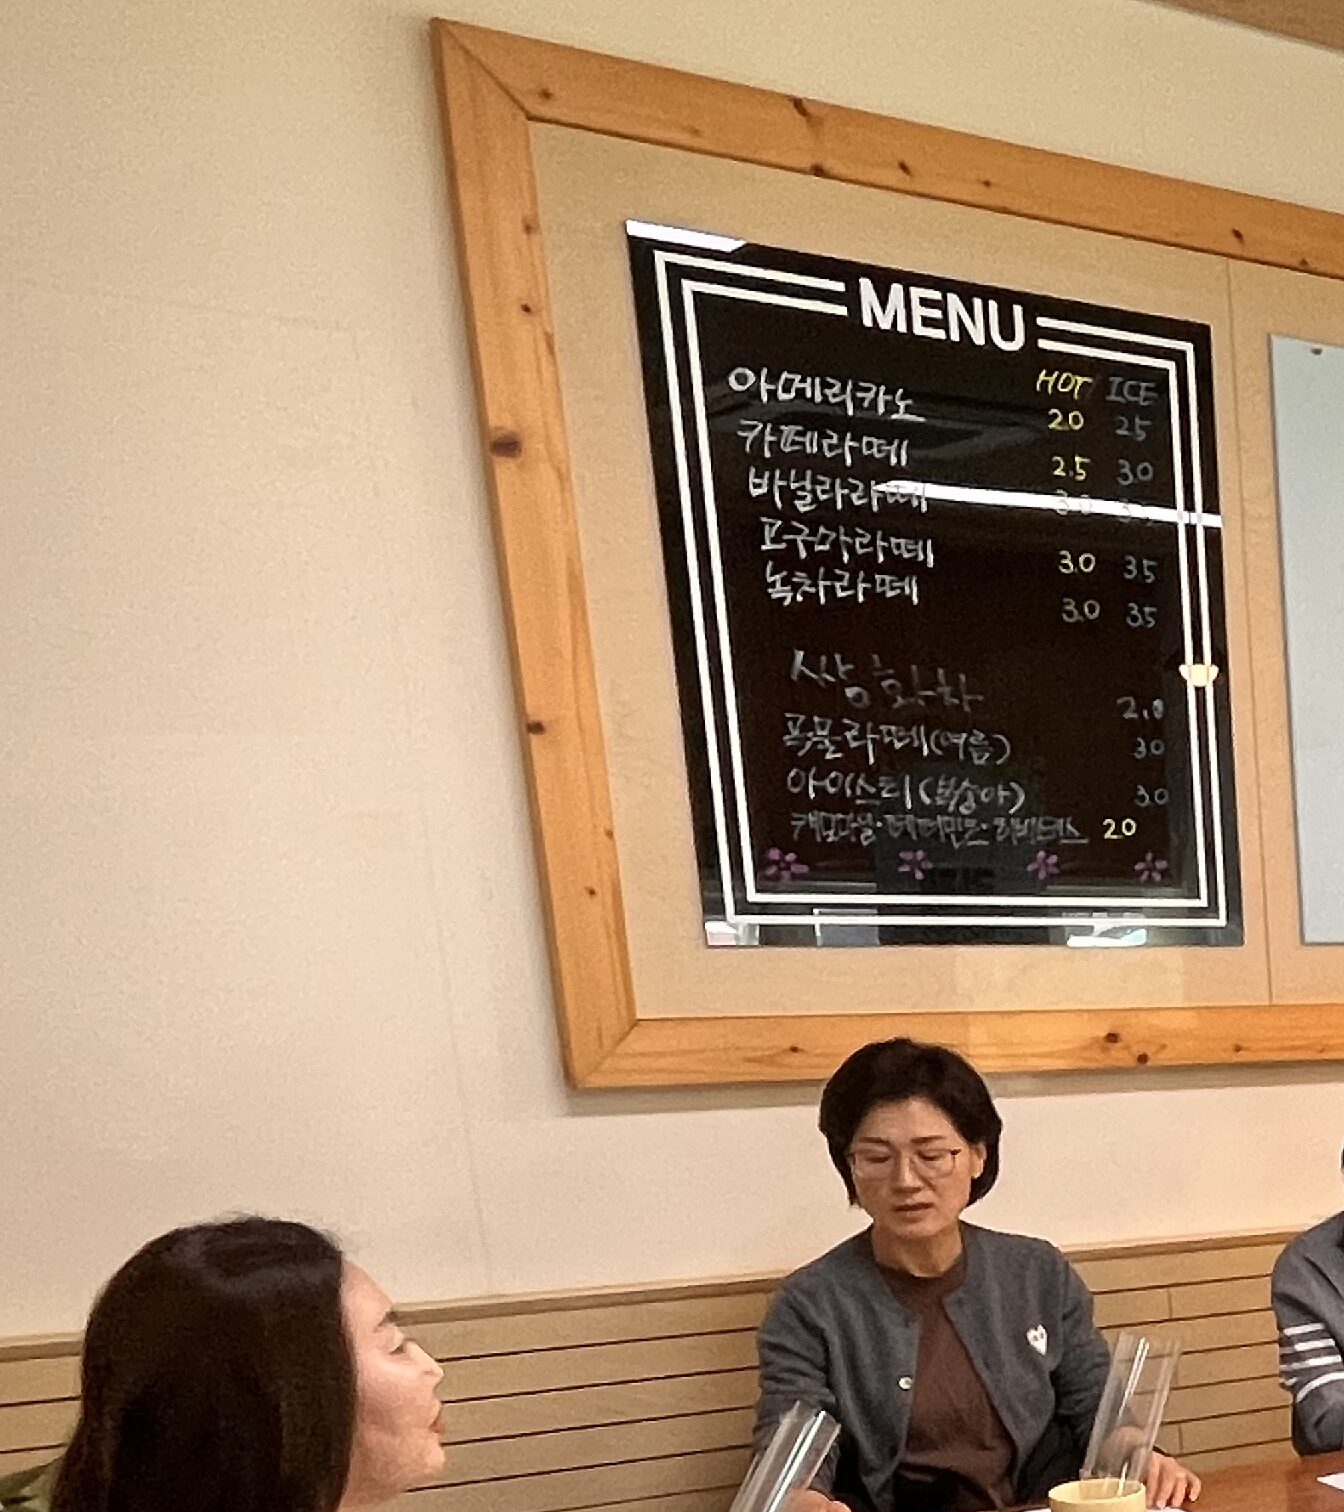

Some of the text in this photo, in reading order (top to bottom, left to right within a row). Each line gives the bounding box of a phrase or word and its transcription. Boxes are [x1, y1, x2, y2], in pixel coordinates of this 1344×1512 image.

[858, 276, 1026, 352] MENU
[728, 366, 927, 422] 아메리카노
[1036, 369, 1158, 406] HOT ICE
[737, 418, 909, 467] 카페라떼
[1052, 453, 1091, 481] 2.5
[760, 516, 934, 568] 고구마라떼
[766, 560, 919, 606] 녹차라떼
